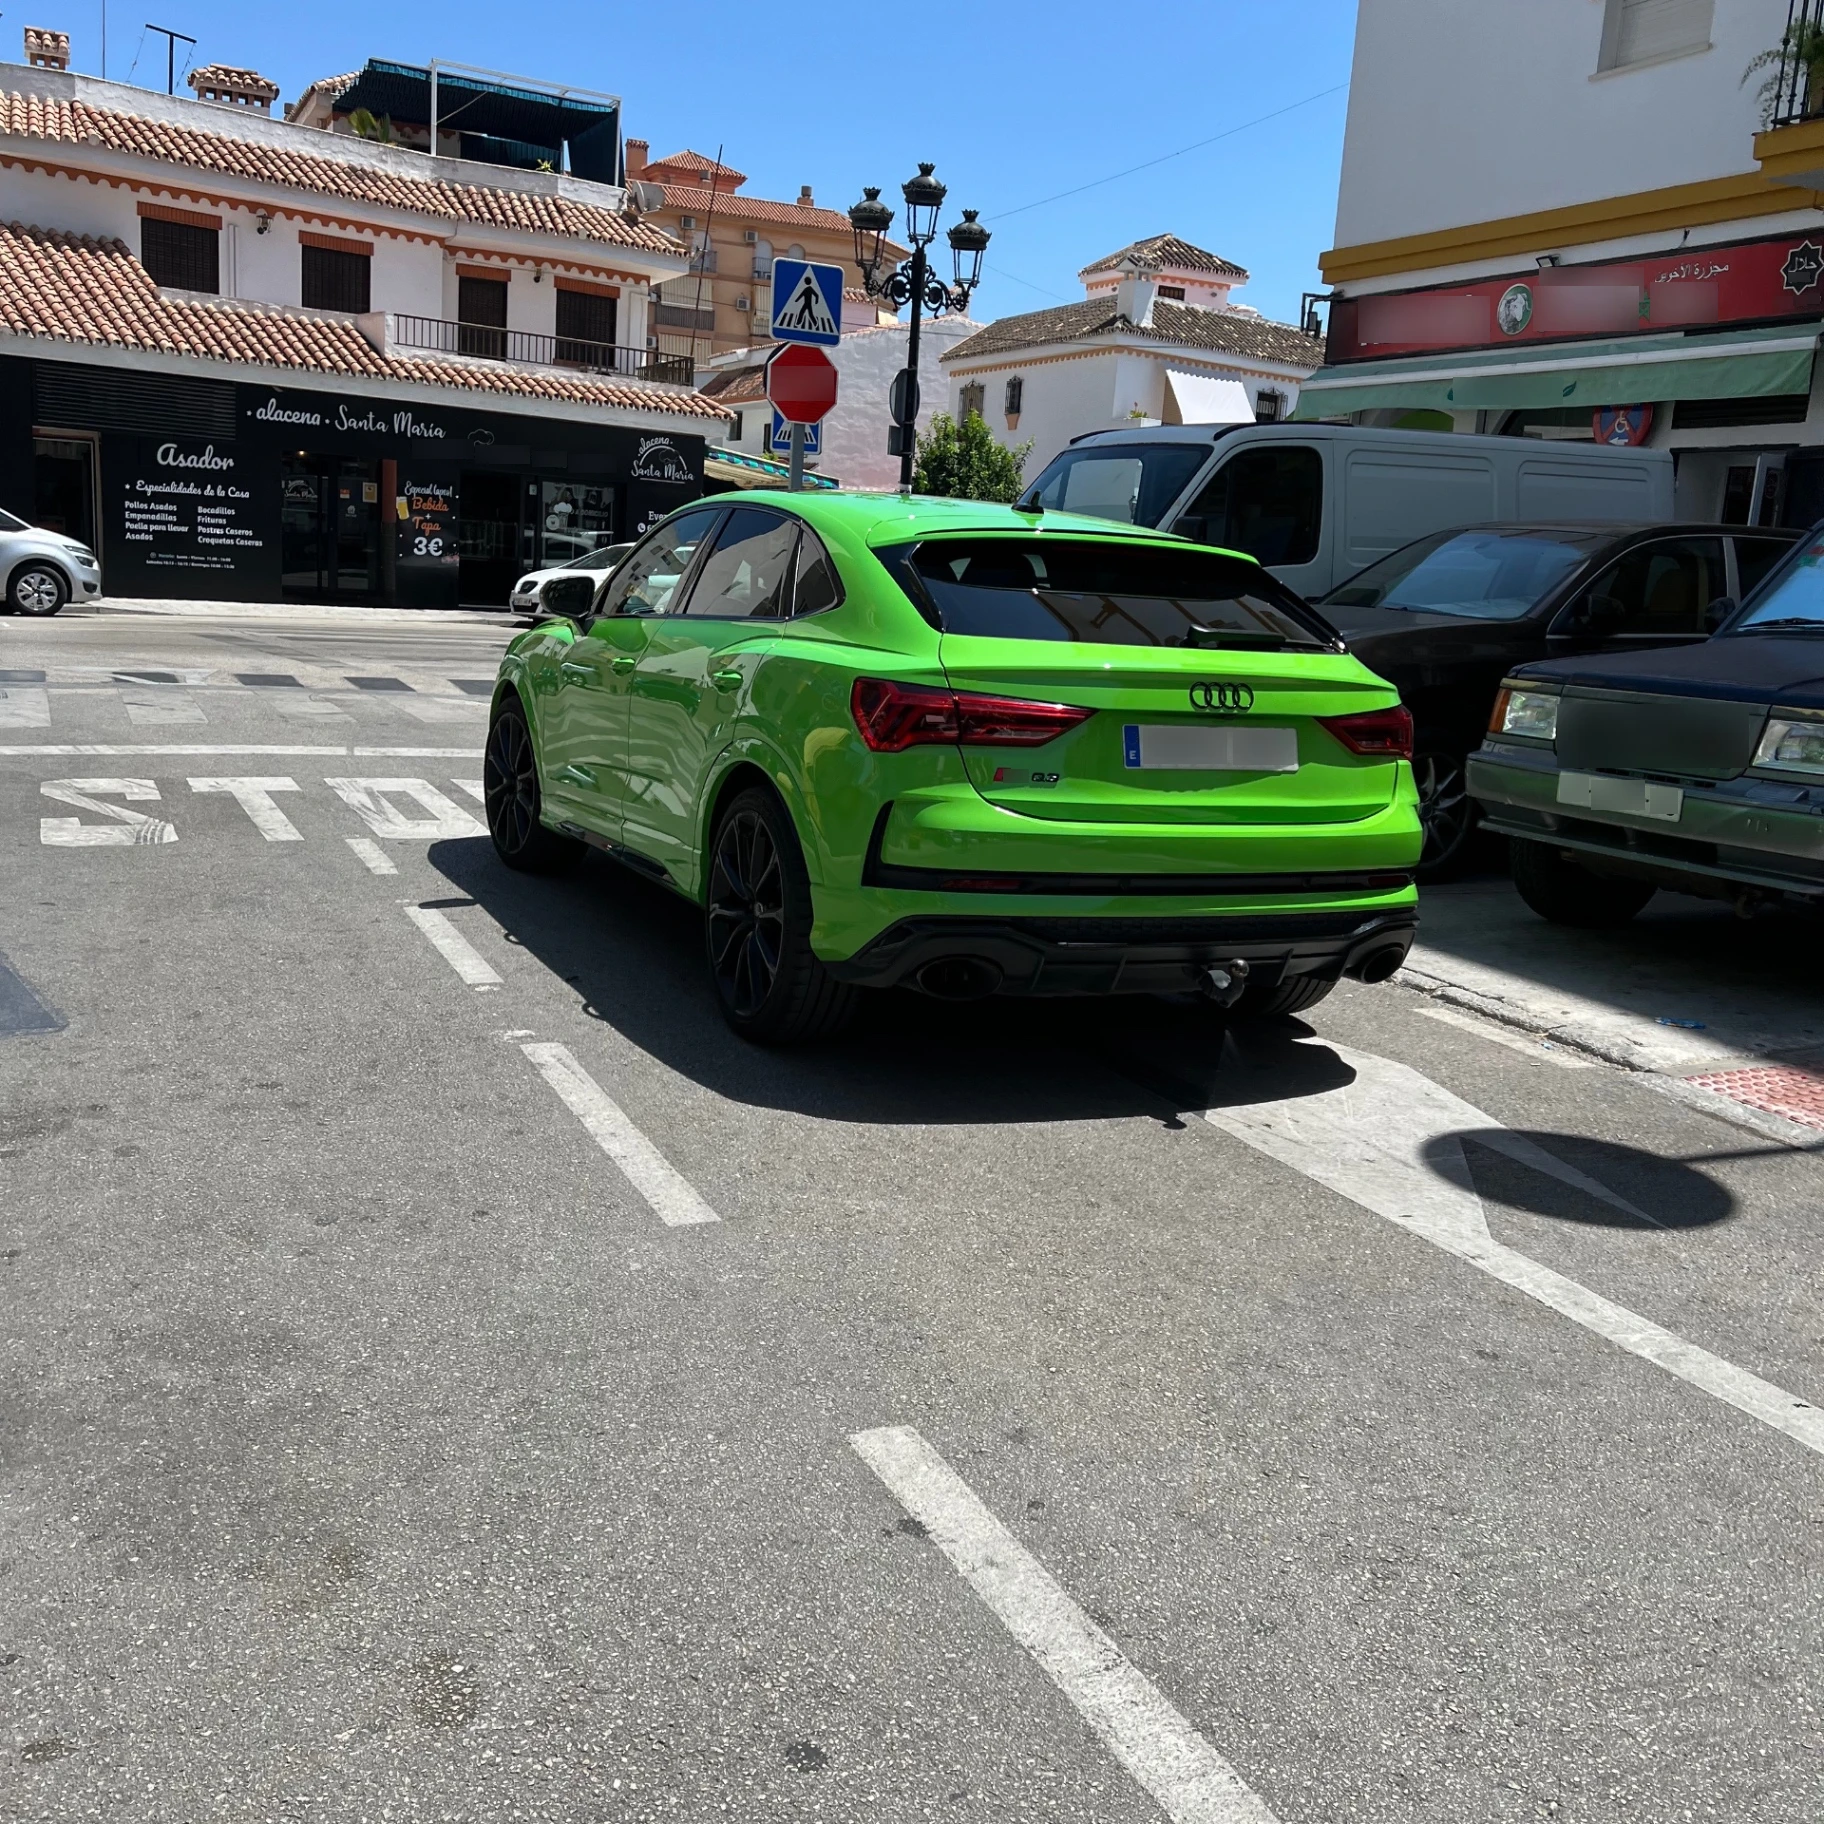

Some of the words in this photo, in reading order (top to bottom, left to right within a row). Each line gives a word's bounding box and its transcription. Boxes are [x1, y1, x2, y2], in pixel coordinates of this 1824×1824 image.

[1694, 261, 1729, 280] مجزرة
[1788, 256, 1818, 273] حلال
[256, 398, 321, 426] alacena
[335, 404, 389, 432] Santa
[393, 411, 446, 438] María
[639, 437, 670, 455] alacena
[157, 443, 234, 470] Asador
[631, 460, 661, 477] Santa
[664, 463, 694, 480] María
[136, 480, 202, 496] Especialidades
[203, 484, 215, 496] de
[216, 485, 226, 497] la
[227, 486, 250, 498] Casa
[125, 501, 148, 509] Pollos
[150, 502, 177, 511] Asados
[197, 506, 235, 515] Bocadillos
[412, 496, 449, 511] Bebida
[125, 511, 177, 521] Empanadillas
[197, 516, 226, 525] Frituras
[125, 522, 148, 530] Paella
[150, 524, 167, 532] para
[168, 524, 189, 532] llevar
[197, 526, 224, 535] Postres
[226, 527, 253, 536] Caseros
[412, 516, 441, 536] Tapa
[125, 532, 153, 541] Asados
[197, 536, 234, 545] Croquetas
[236, 538, 263, 546] Caseras
[413, 537, 443, 556] 3€
[1129, 750, 1137, 760] E
[40, 776, 490, 847] STO
